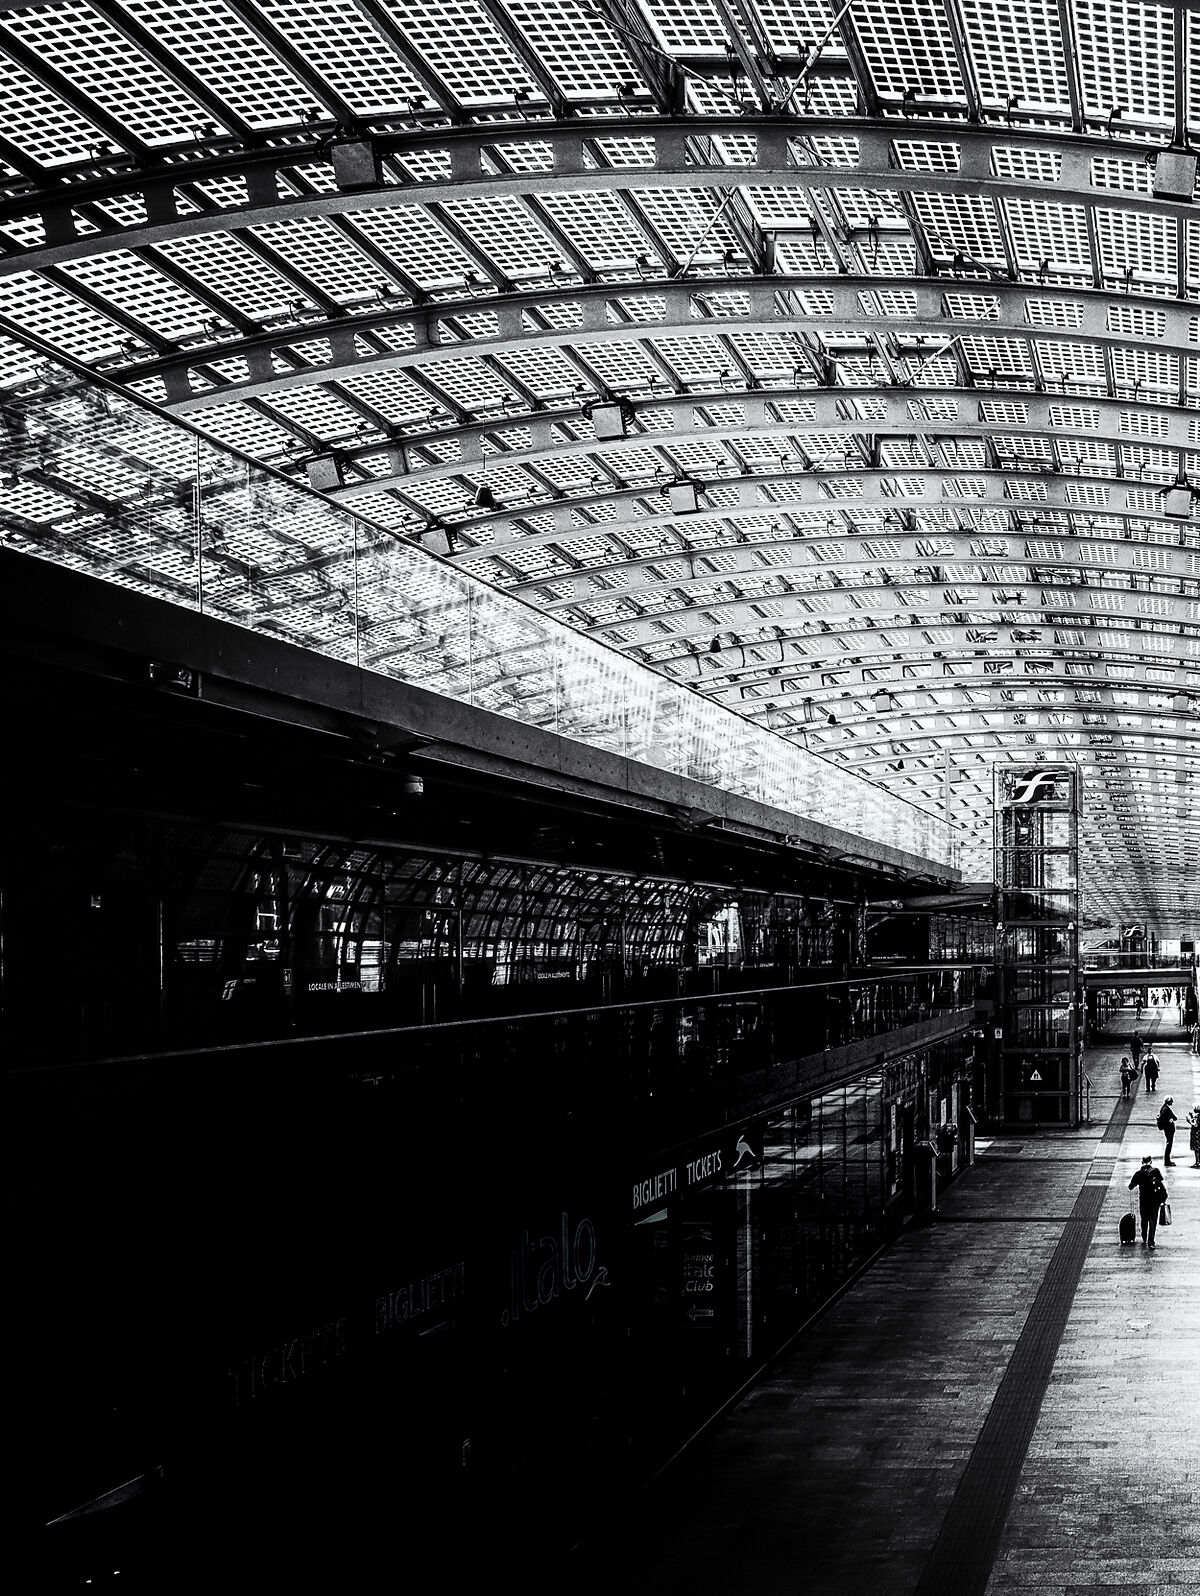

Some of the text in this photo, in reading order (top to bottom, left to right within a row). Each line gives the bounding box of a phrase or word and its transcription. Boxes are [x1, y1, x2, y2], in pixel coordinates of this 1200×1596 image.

[633, 1150, 721, 1209] BIGLIETTI TICKETS
[685, 1280, 714, 1292] Club
